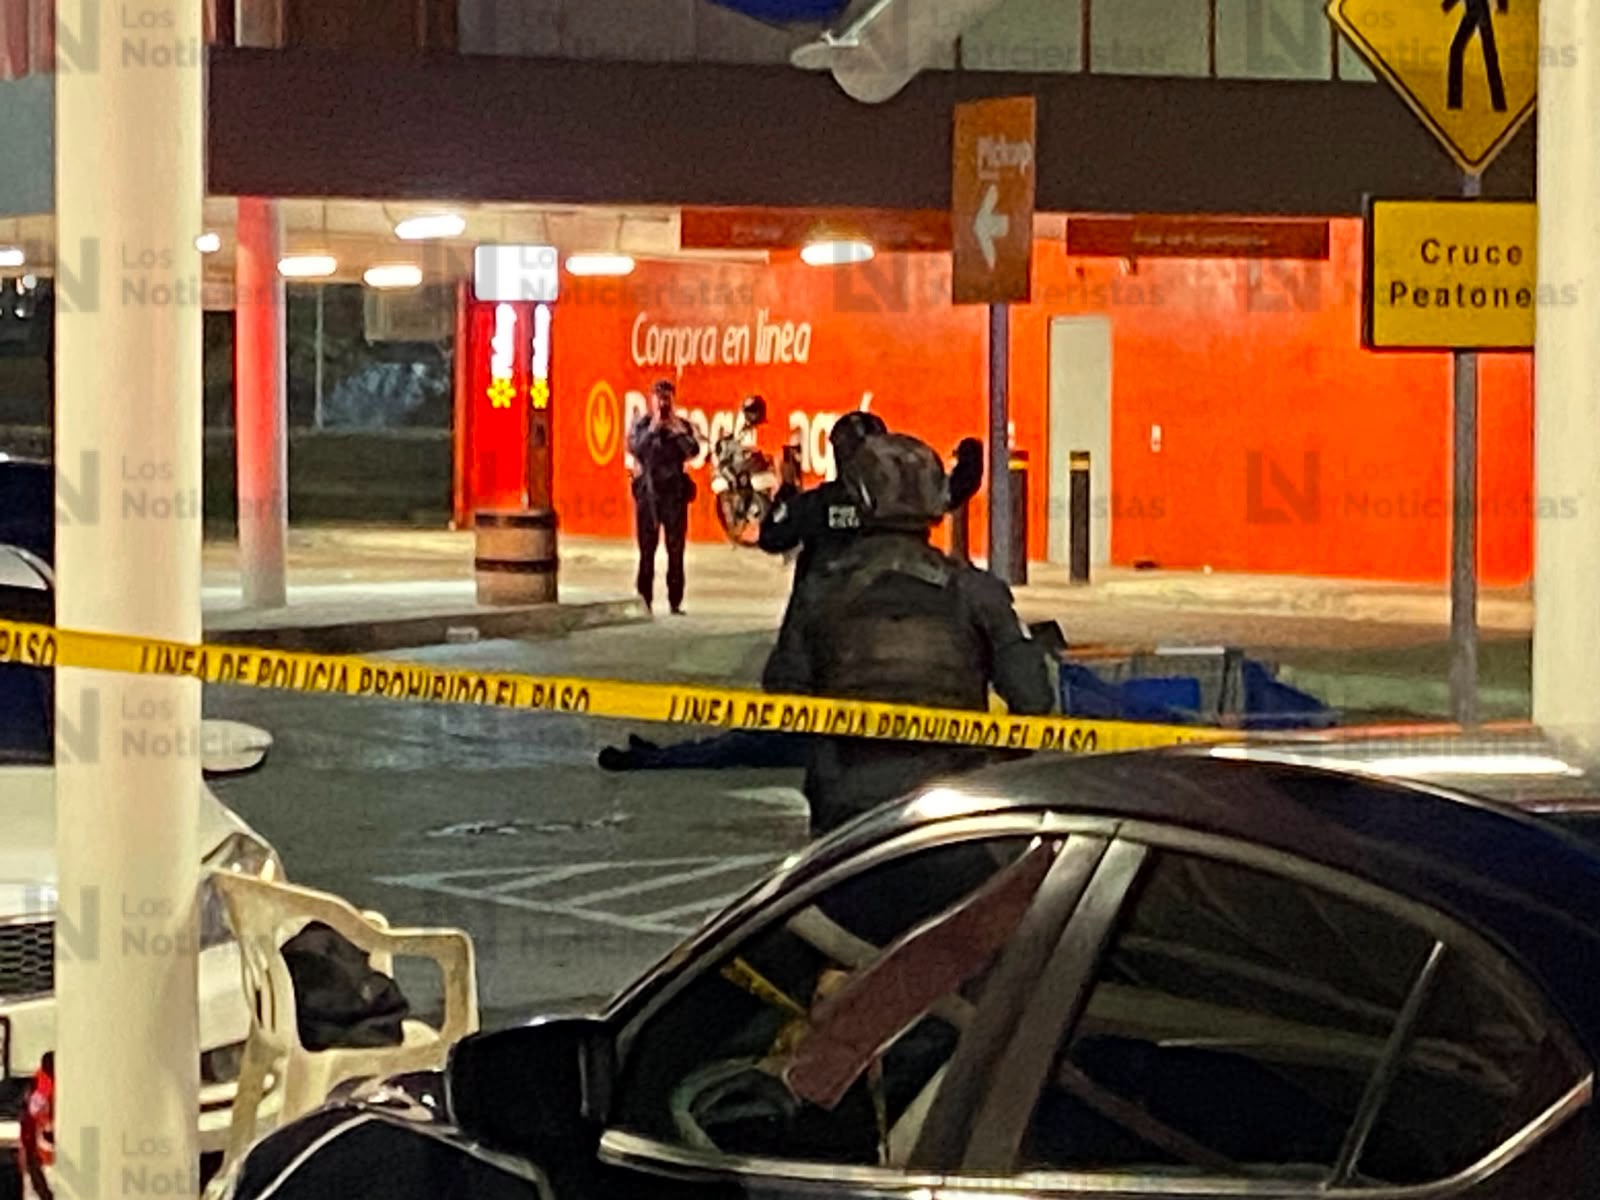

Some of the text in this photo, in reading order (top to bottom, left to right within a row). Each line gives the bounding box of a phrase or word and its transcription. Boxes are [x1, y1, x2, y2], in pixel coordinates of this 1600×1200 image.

[1421, 238, 1523, 265] Cruce
[631, 311, 717, 378] Compra
[722, 323, 750, 366] en
[217, 654, 252, 681] DE
[531, 684, 590, 711] PASO
[743, 701, 774, 727] DE
[1040, 727, 1098, 753] PASO
